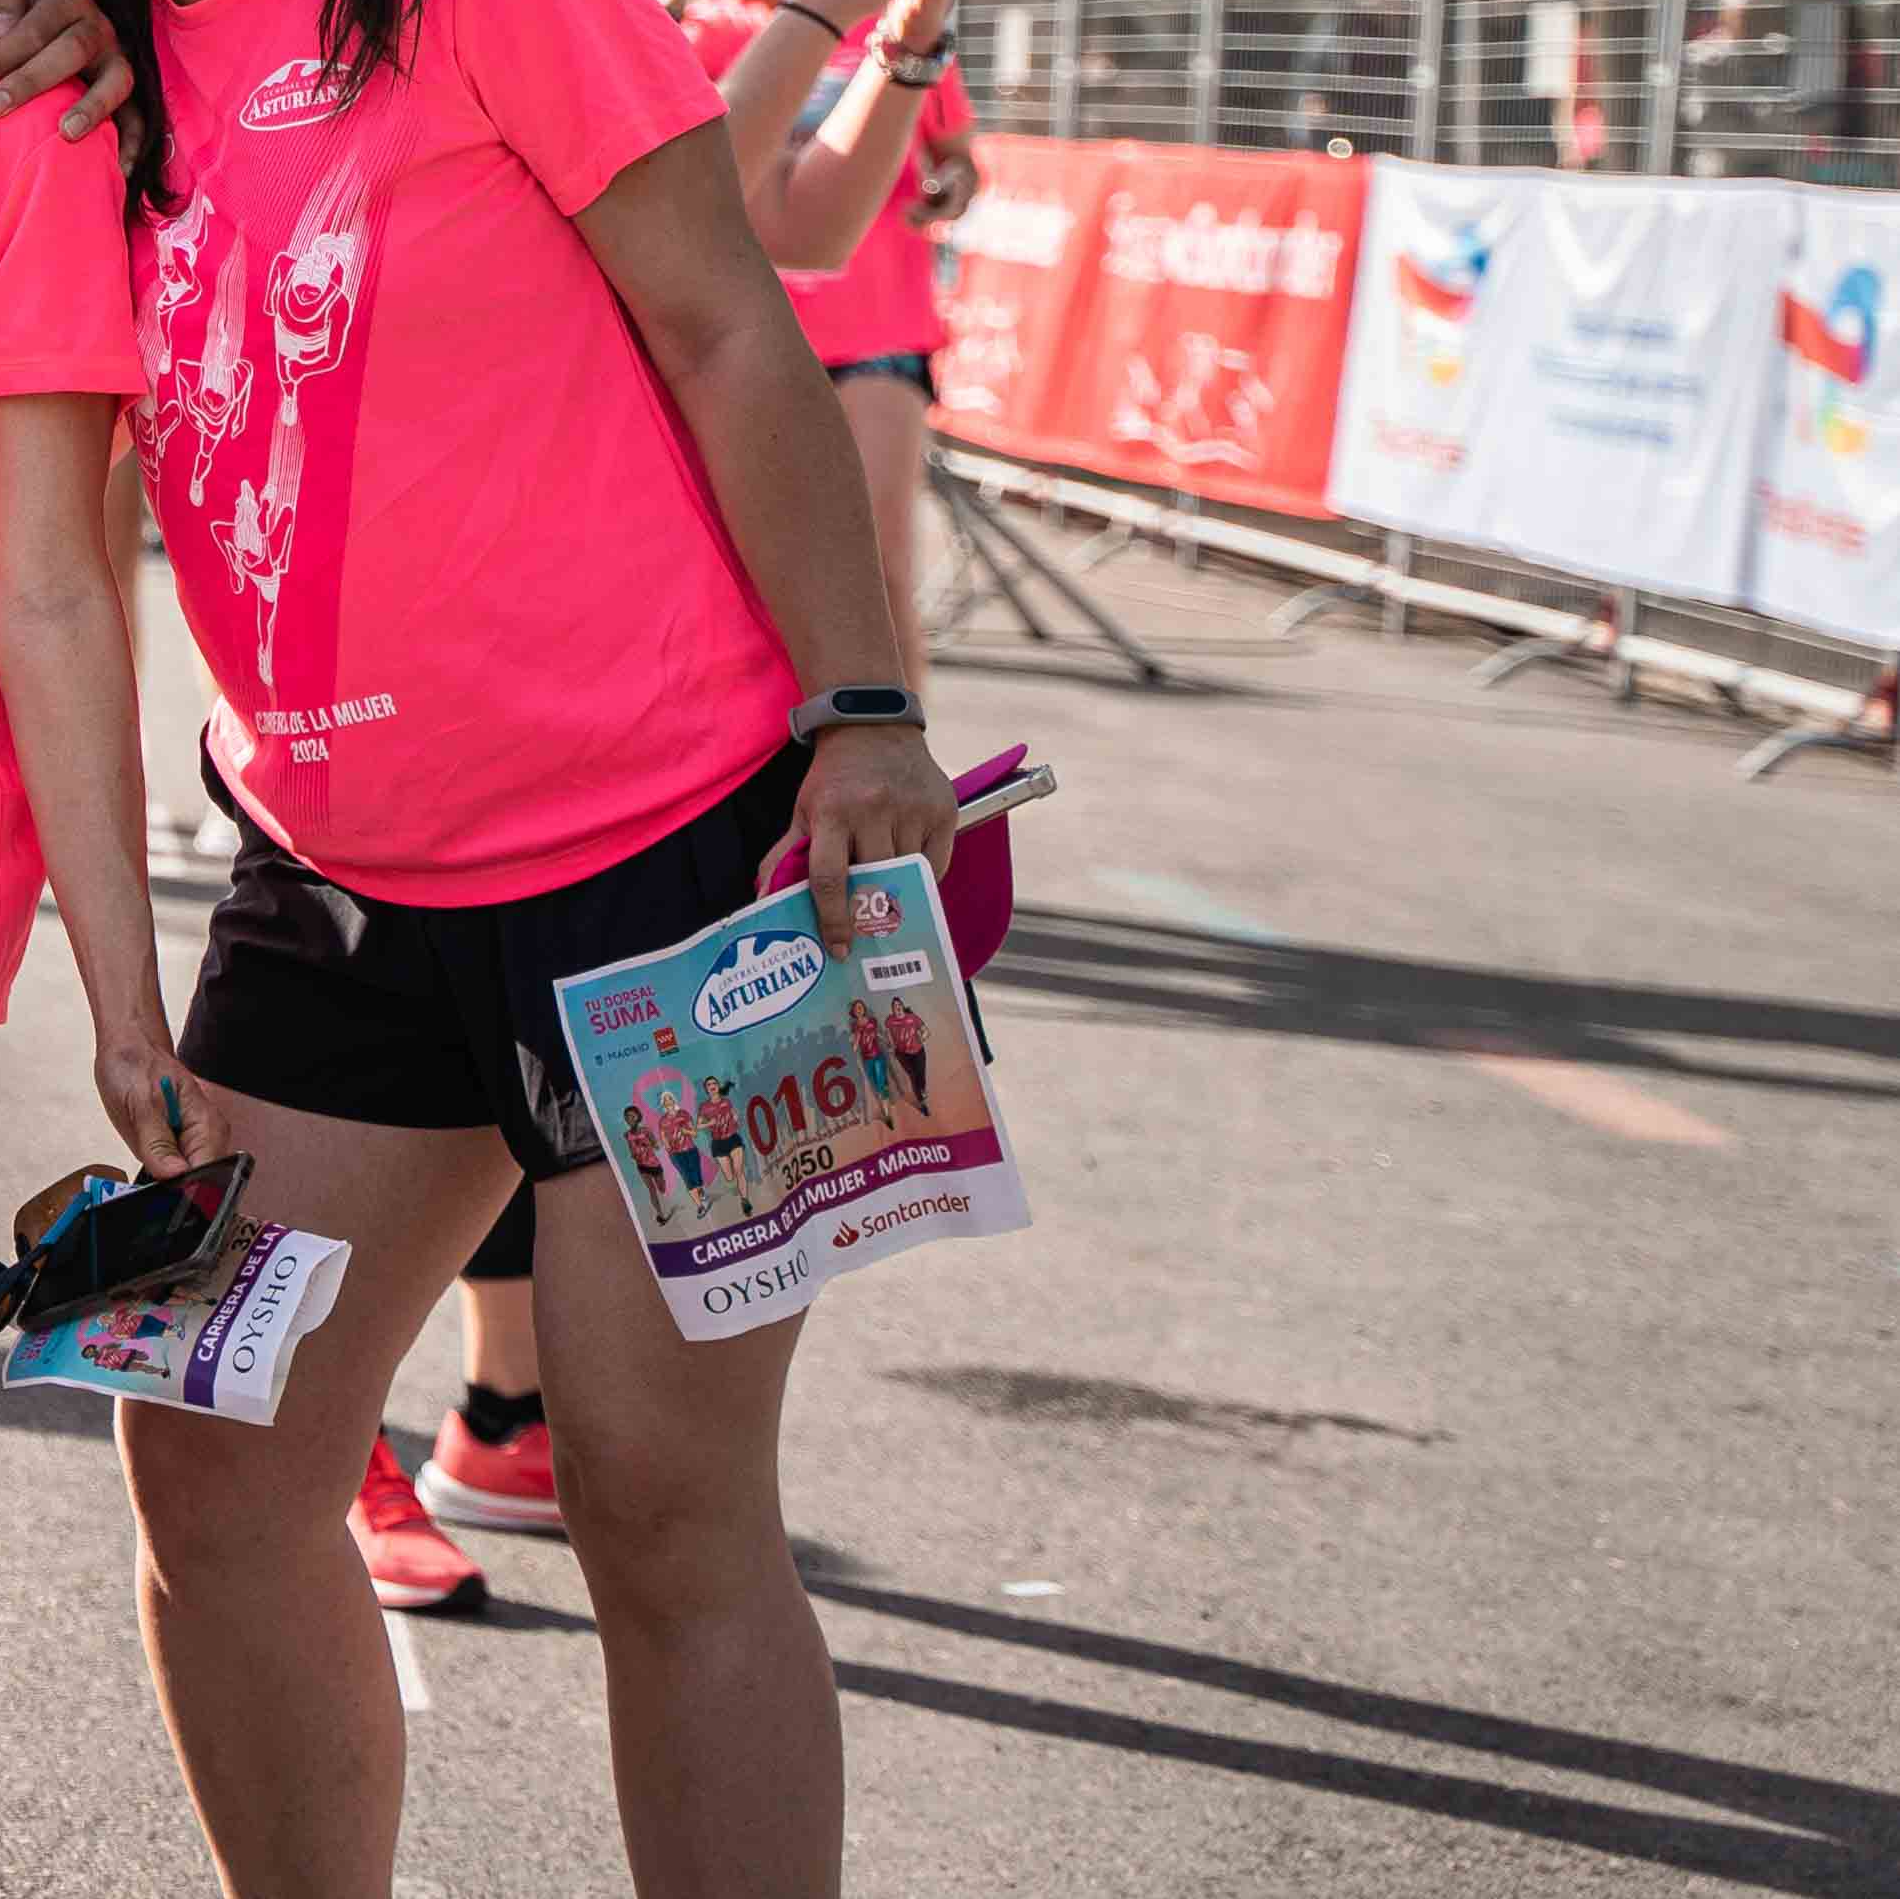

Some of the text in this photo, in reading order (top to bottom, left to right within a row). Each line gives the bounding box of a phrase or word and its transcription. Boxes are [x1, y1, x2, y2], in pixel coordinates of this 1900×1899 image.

[248, 85, 340, 122] ASTURIAN
[307, 708, 333, 733] LA
[332, 693, 397, 728] MUJER
[290, 737, 329, 764] 2024
[856, 890, 889, 920] 20
[585, 985, 656, 1013] TU DORSAL
[708, 952, 818, 1029] ASTURIANA
[590, 1000, 660, 1035] SUMA
[746, 1057, 857, 1157] 016
[781, 1145, 834, 1191] 3250
[692, 1219, 783, 1265] CARRERA
[804, 1170, 866, 1210] MUJER
[878, 1143, 951, 1178] MADRID
[861, 1193, 971, 1239] Santander
[197, 1230, 280, 1362] CARRERA DE LA
[704, 1249, 810, 1314] OYSHO
[232, 1255, 298, 1374] OYSHO
